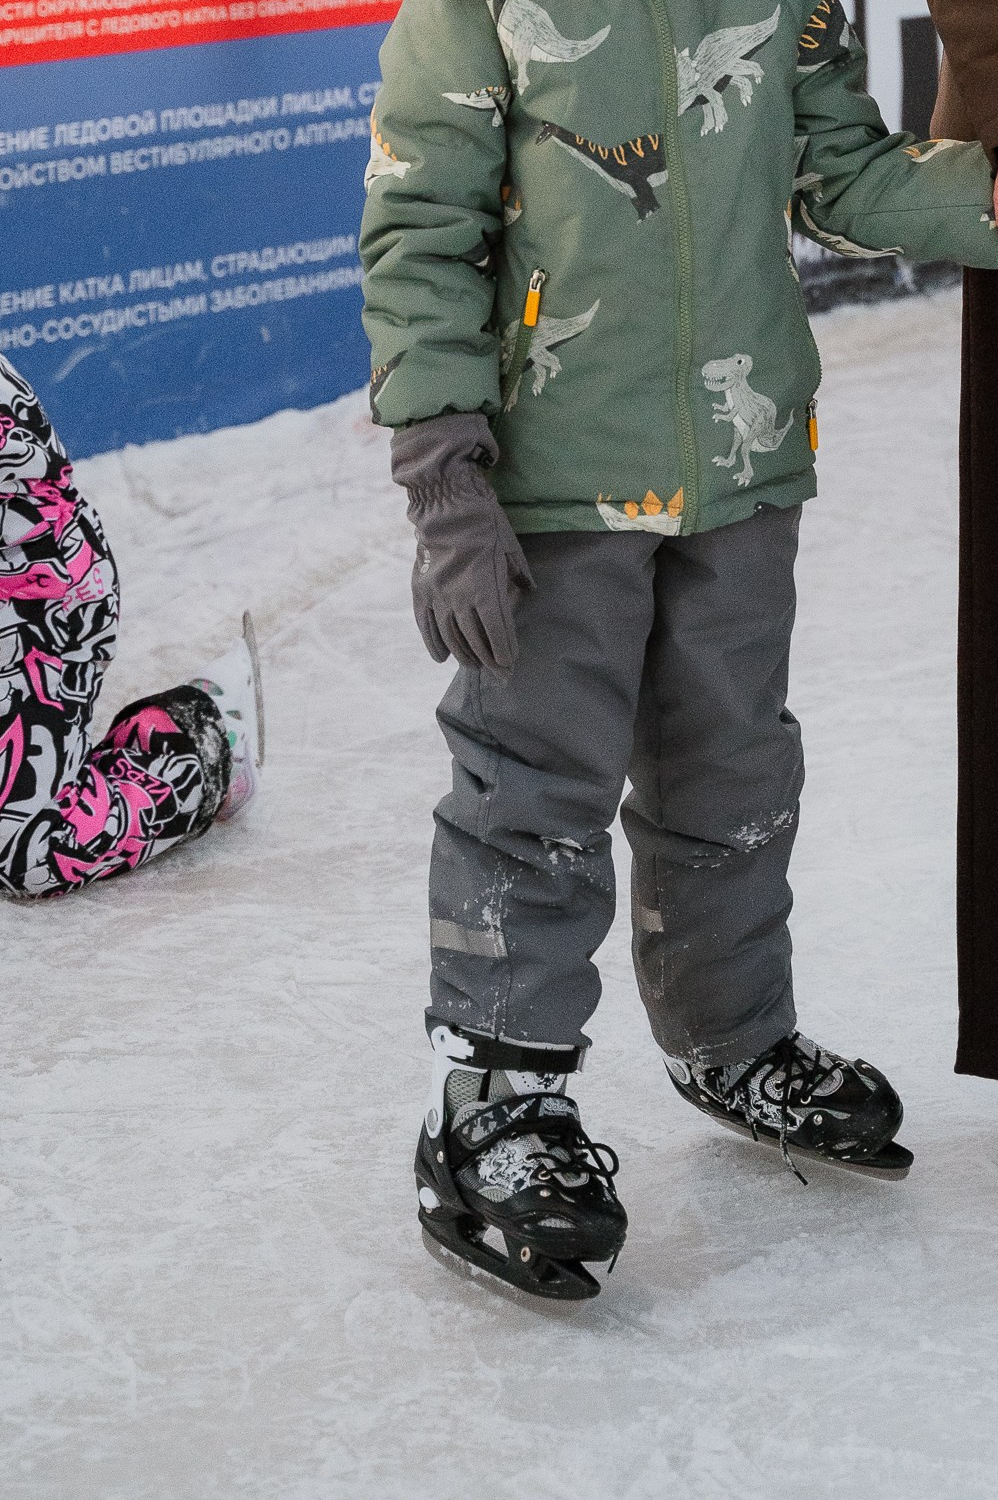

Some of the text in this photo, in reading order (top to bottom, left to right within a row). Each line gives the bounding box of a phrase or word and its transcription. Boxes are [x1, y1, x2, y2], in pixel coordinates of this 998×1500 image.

[0, 115, 371, 190] ОЙСТВОМ ВЕСТИБУЛЯРНОГО АППАРА
[54, 111, 156, 147] ЛЕДОВОЙ
[161, 98, 279, 135] ПЛОЩАДКИ
[282, 86, 354, 114] ЛИЦАМ,
[0, 234, 355, 316] ЕНИЕ КАТКА ЛИЦАМ, СТРАДАЮЩИМ
